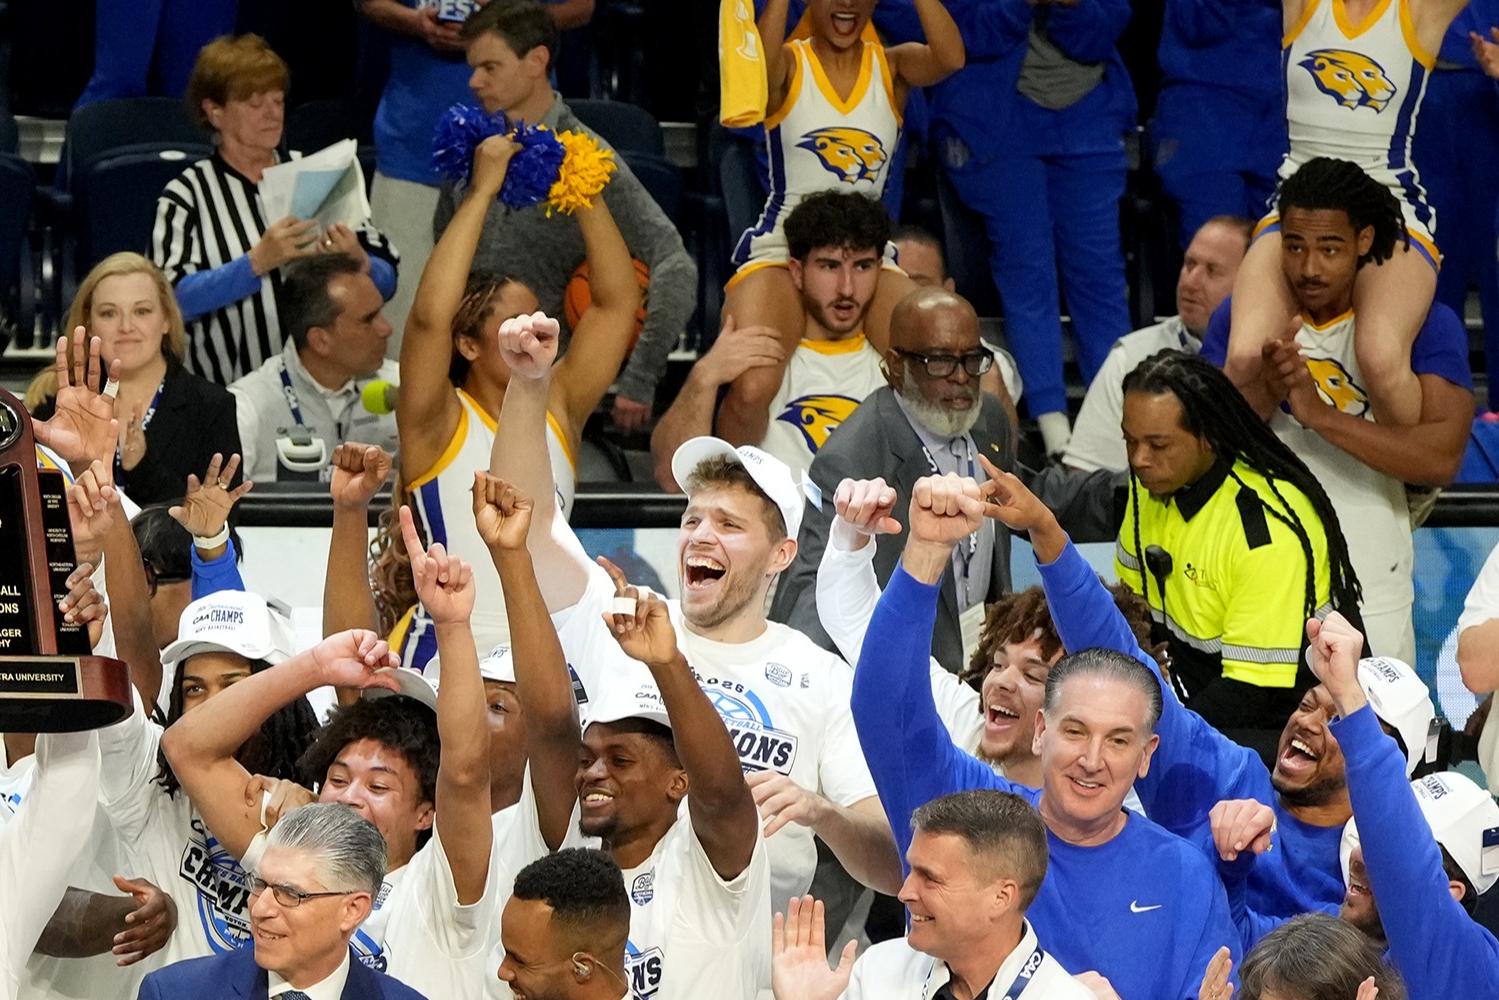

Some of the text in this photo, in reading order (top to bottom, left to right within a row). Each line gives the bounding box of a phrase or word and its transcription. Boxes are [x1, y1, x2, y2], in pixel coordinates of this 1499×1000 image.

[192, 609, 244, 625] CAA CHAMPS
[15, 673, 64, 682] UNIVERSITY
[635, 692, 657, 700] CAA
[1020, 952, 1041, 979] CAA
